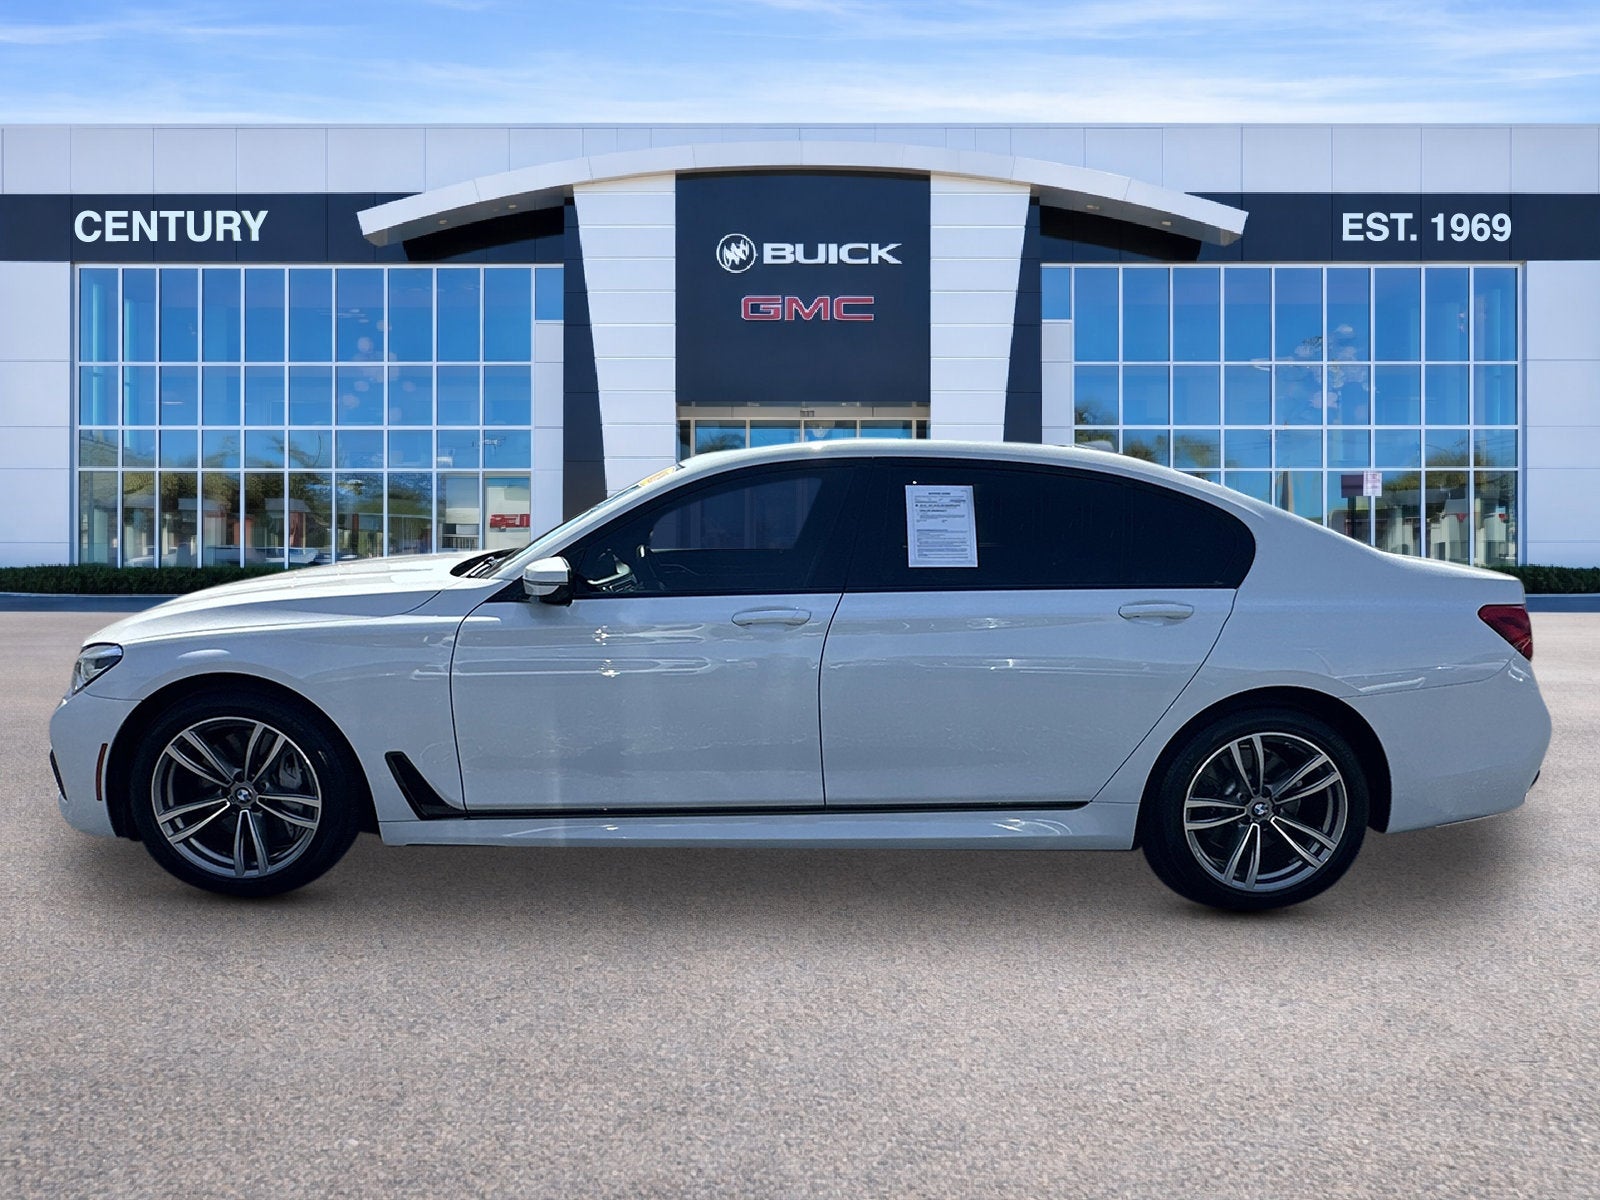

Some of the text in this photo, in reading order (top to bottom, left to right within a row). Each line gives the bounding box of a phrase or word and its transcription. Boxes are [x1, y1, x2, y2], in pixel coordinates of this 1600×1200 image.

[74, 209, 268, 243] CENTURY
[1342, 212, 1512, 242] EST. 1969
[763, 243, 903, 265] BUICK
[741, 295, 875, 321] GMC
